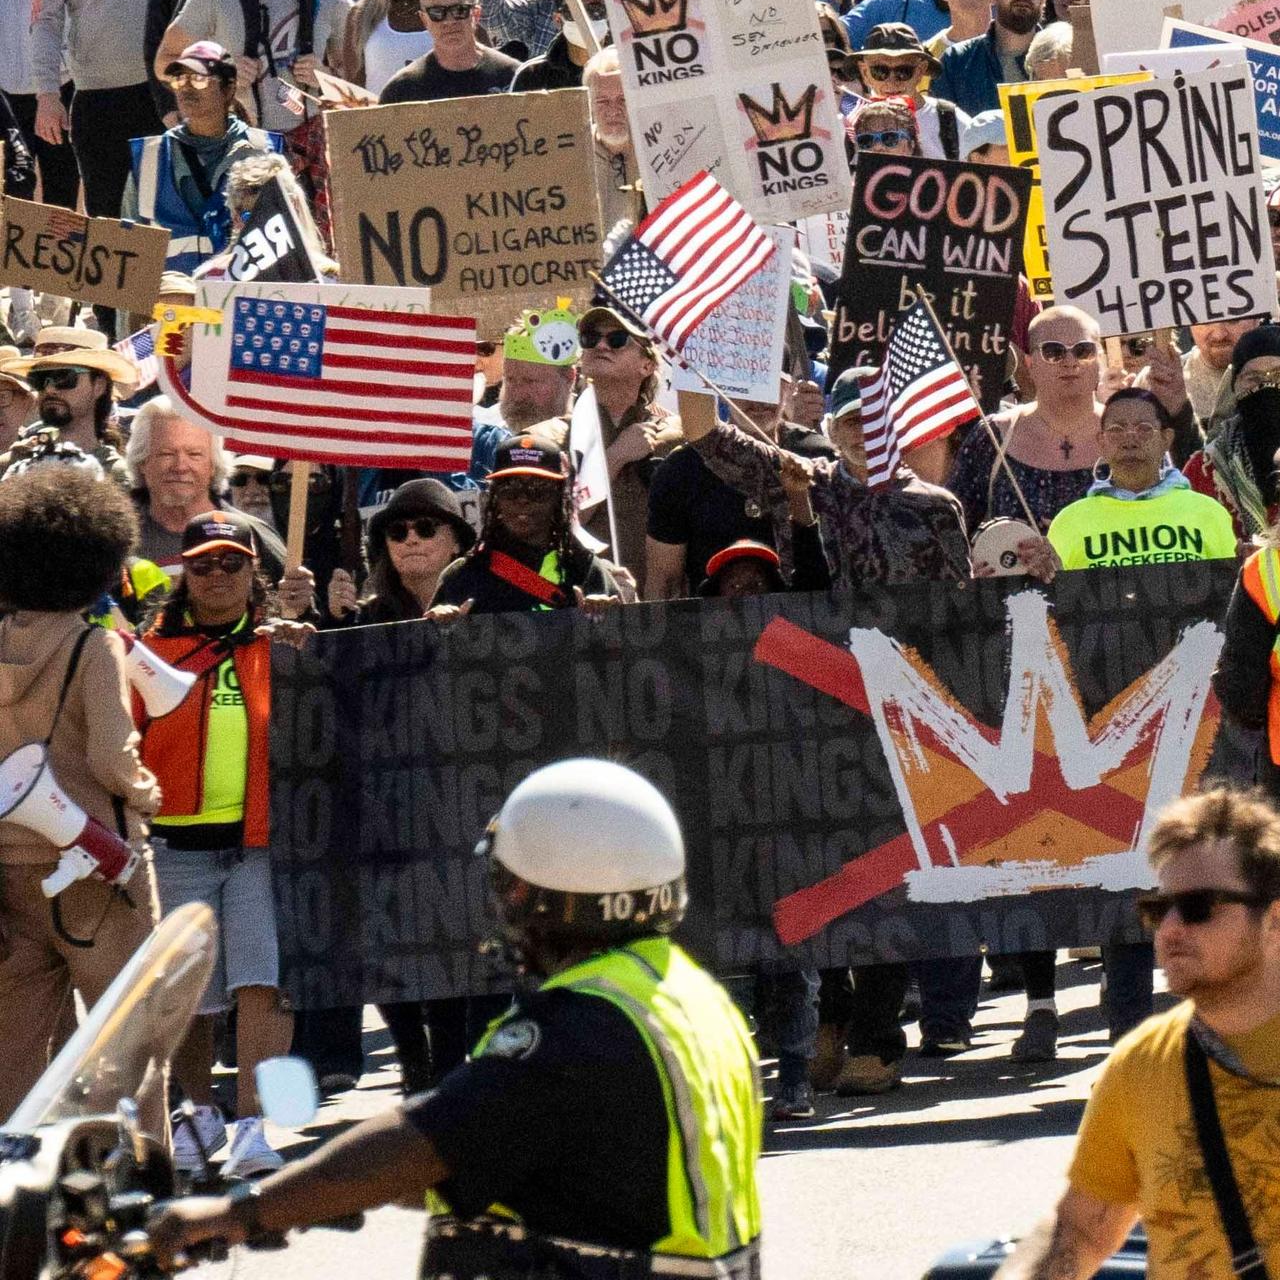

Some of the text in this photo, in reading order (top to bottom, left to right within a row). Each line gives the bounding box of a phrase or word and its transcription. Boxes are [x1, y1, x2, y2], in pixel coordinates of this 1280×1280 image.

[632, 36, 700, 71] NO
[637, 64, 705, 87] KINGS
[757, 140, 824, 177] NO
[1047, 75, 1256, 212] SPRING
[465, 185, 566, 217] KINGS
[761, 174, 829, 196] KINGS
[863, 165, 1020, 228] GOOD
[359, 206, 448, 285] NO
[454, 224, 598, 258] OLIGARCHS
[857, 226, 1014, 271] CAN WIN
[1047, 187, 1264, 299] STEEN
[1100, 270, 1256, 334] 4-PRES
[1084, 525, 1203, 560] UNION
